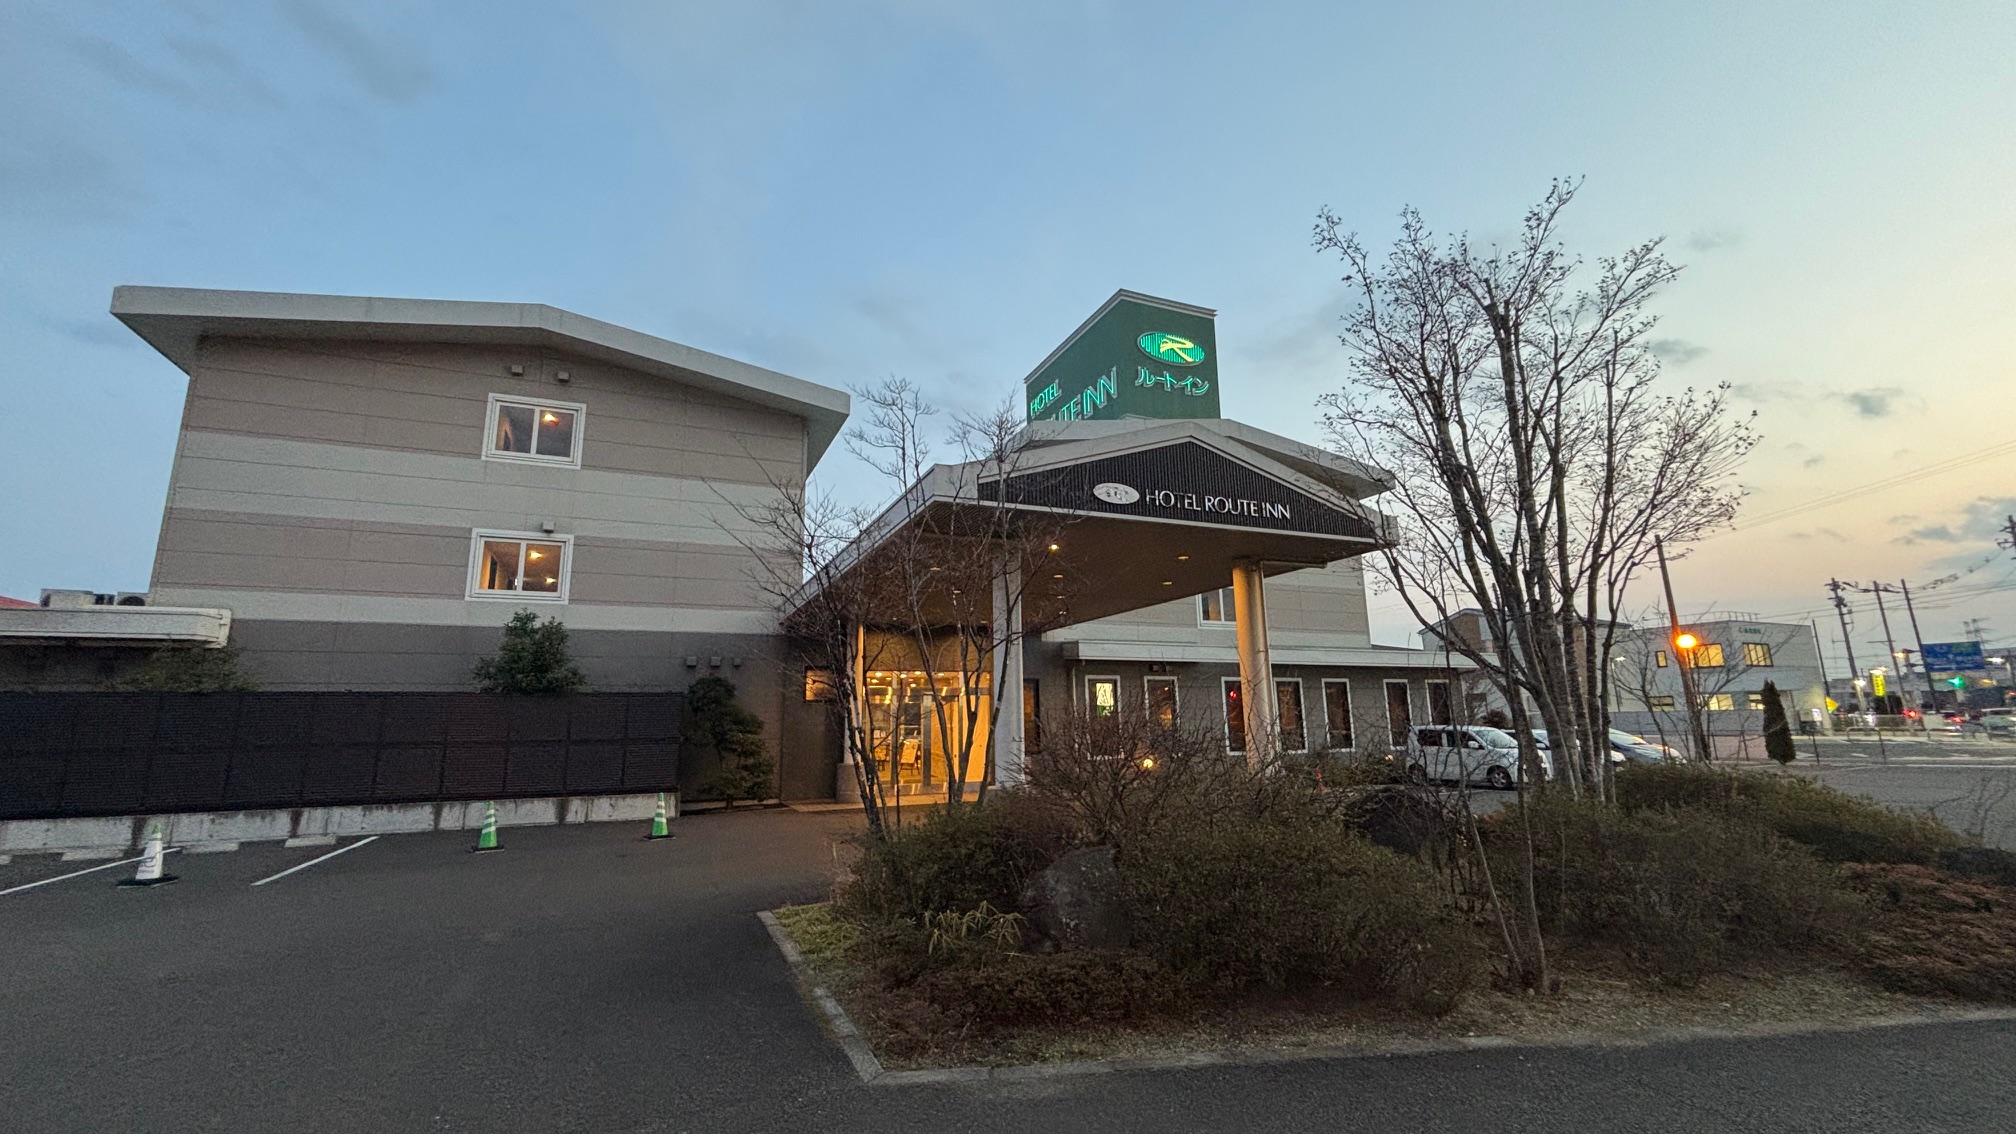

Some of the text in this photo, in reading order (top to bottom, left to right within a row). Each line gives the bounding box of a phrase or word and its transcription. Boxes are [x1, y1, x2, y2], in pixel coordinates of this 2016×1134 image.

[1083, 366, 1118, 419] INN
[1135, 366, 1209, 396] ルートイン
[1030, 379, 1062, 419] HOTEL
[1146, 489, 1201, 511] HOTEL
[1205, 494, 1258, 517] ROUTE
[1262, 502, 1291, 520] INN
